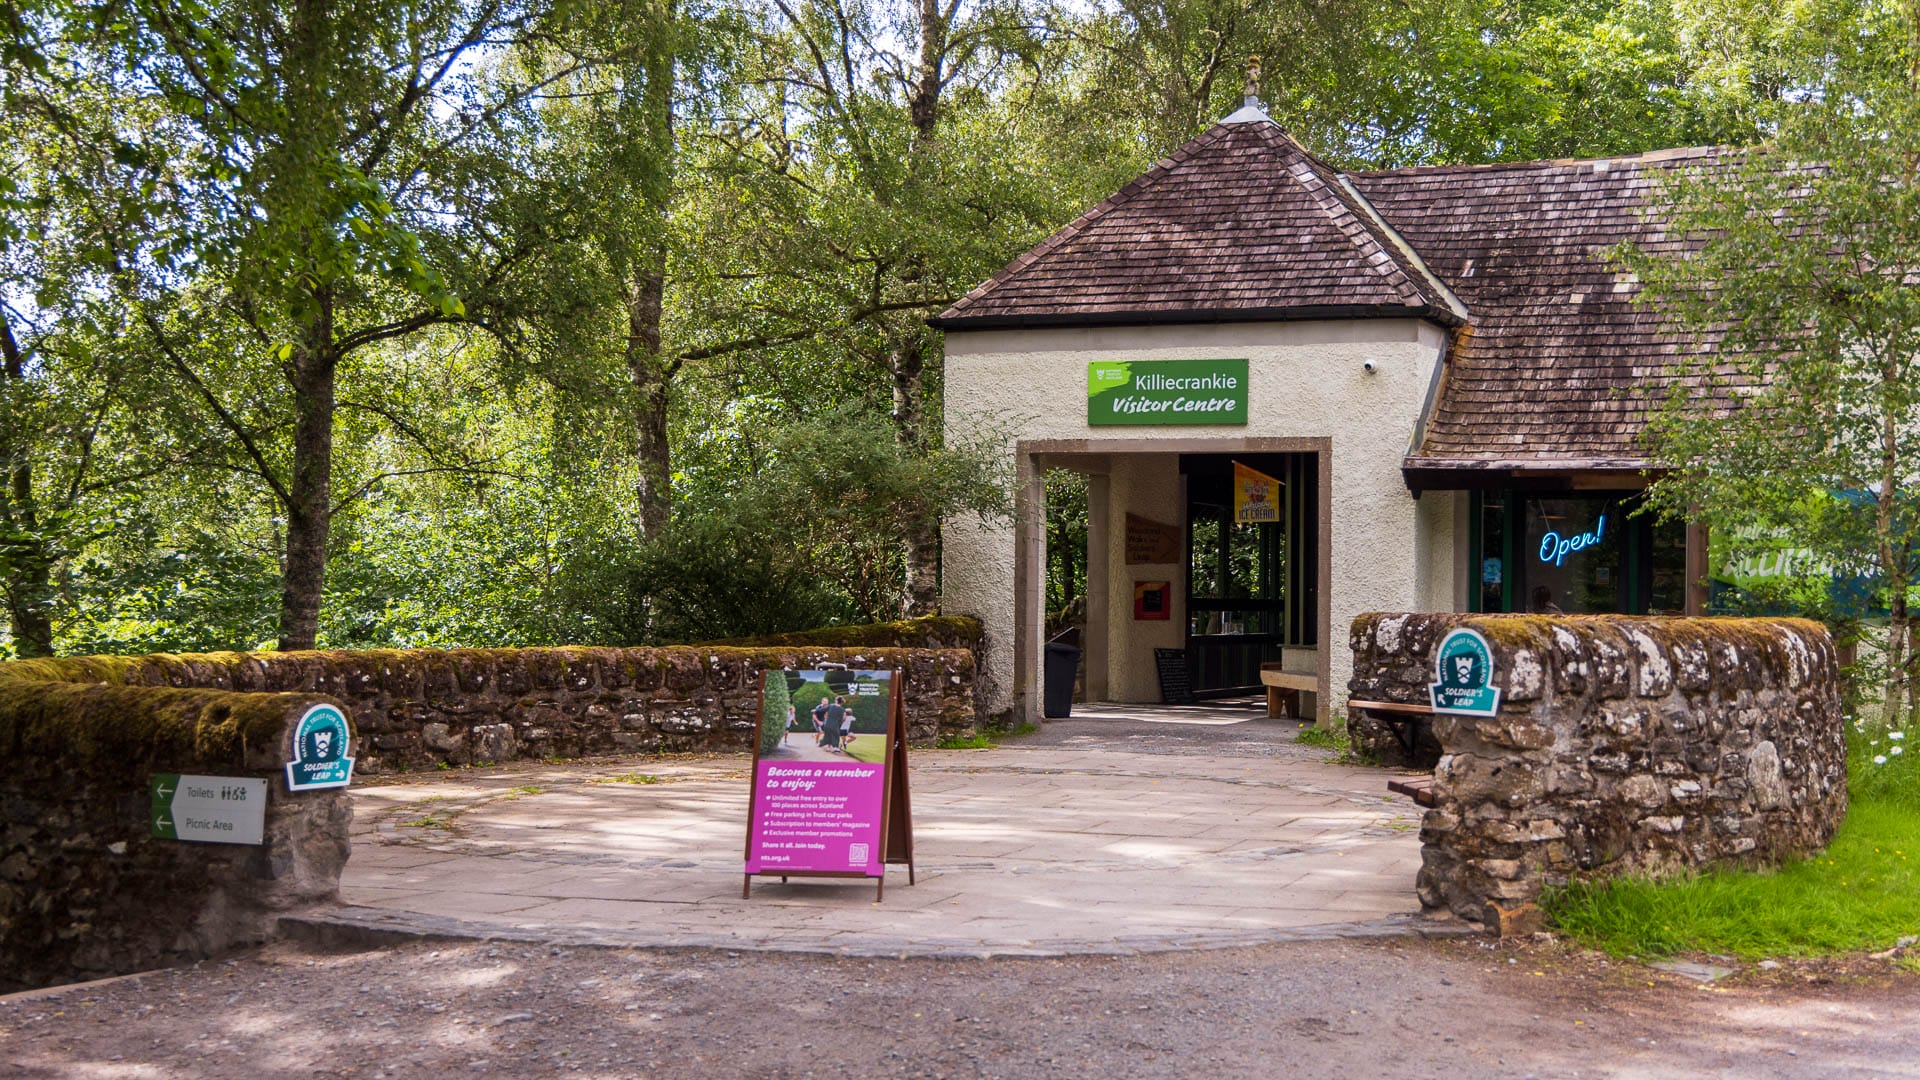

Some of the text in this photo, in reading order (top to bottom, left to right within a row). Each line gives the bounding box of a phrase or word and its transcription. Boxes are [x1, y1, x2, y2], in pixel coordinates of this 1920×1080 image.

[1136, 373, 1237, 390] Killiecrankie
[1112, 395, 1236, 414] Visitor Centre
[1539, 515, 1604, 567] Open!
[1444, 687, 1483, 697] SOLDIER'S
[1453, 698, 1474, 707] LEAP
[300, 713, 344, 758] NATIONAL TRUST FOR SCOTLAND
[303, 761, 340, 772] SOLDIER'S
[768, 767, 876, 777] Become a member
[312, 772, 331, 780] LEAP
[766, 778, 816, 791] to enjoy:
[187, 787, 215, 799] Toilets
[186, 818, 233, 831] Picnic Area
